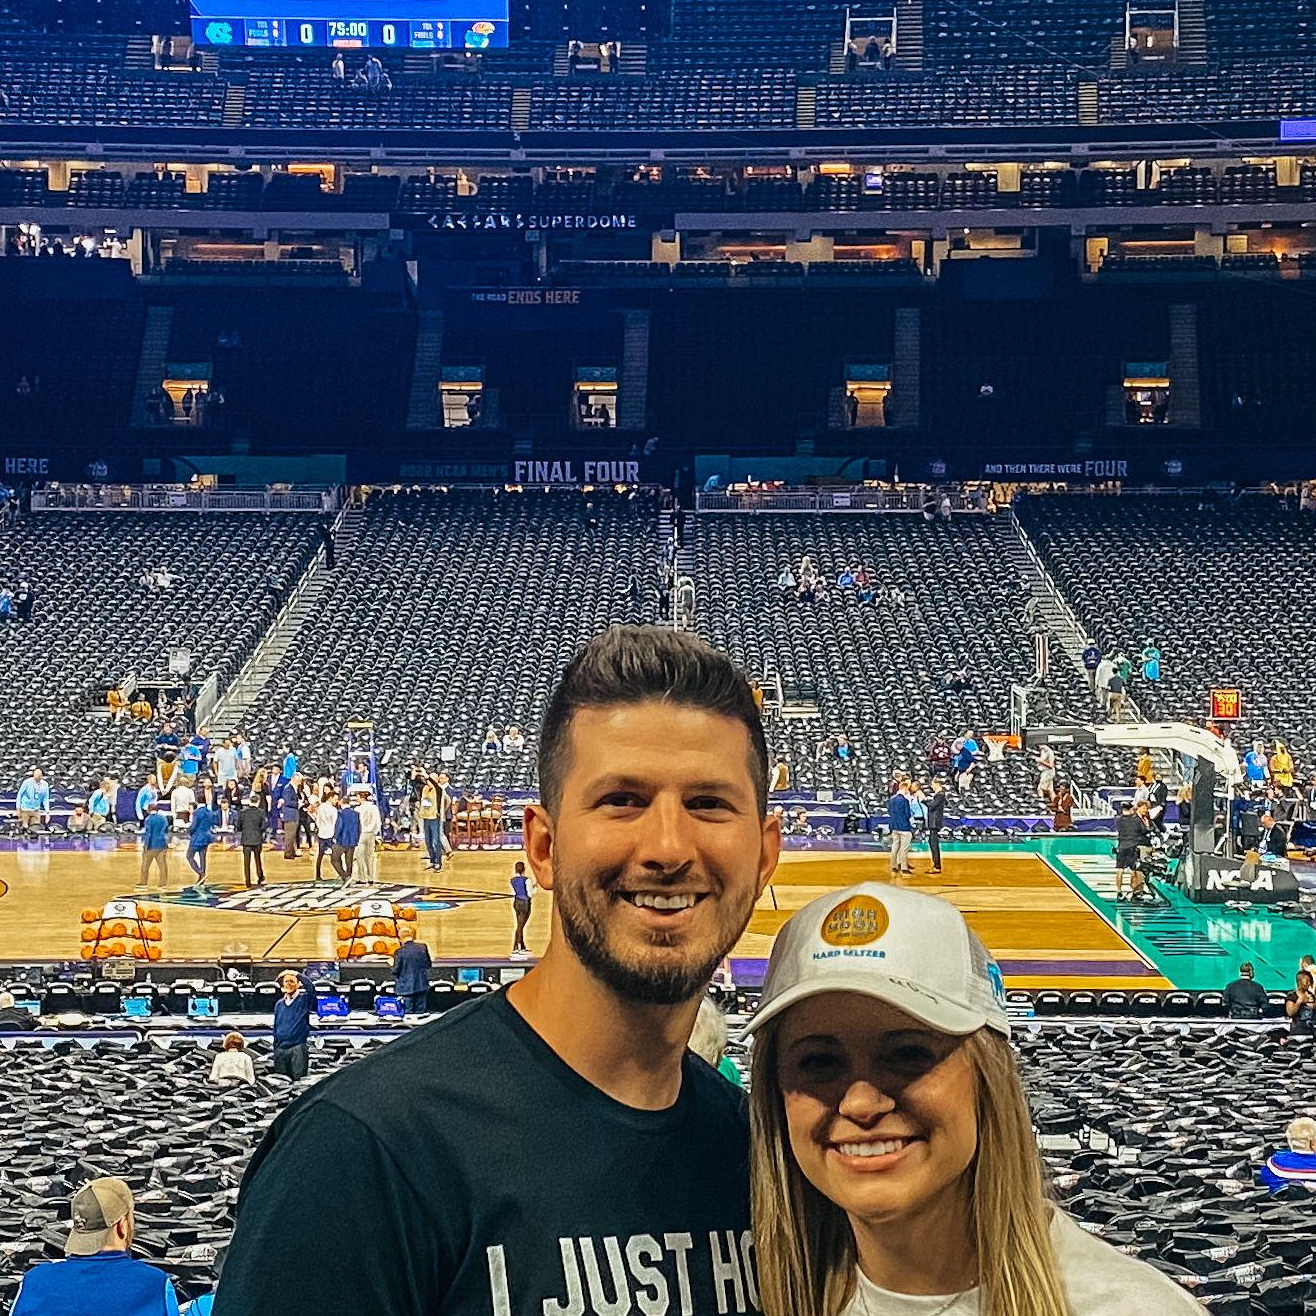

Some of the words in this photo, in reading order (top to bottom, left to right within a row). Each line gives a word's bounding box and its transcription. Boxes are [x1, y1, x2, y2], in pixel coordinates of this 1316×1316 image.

[300, 23, 313, 44] 0
[328, 21, 368, 37] 75:00
[383, 24, 395, 44] 0
[527, 214, 637, 229] SUPERDOME
[508, 290, 542, 304] ENDS
[546, 290, 581, 304] HERE
[4, 458, 50, 474] HERE
[514, 461, 578, 483] FINAL
[584, 461, 640, 483] FOUR
[985, 463, 1003, 474] AND
[1057, 464, 1082, 474] WERE
[1084, 460, 1128, 477] FOUR
[1205, 869, 1275, 891] NCA
[812, 948, 842, 961] HARD
[843, 947, 887, 960] SELTZER
[709, 1229, 762, 1314] HO
